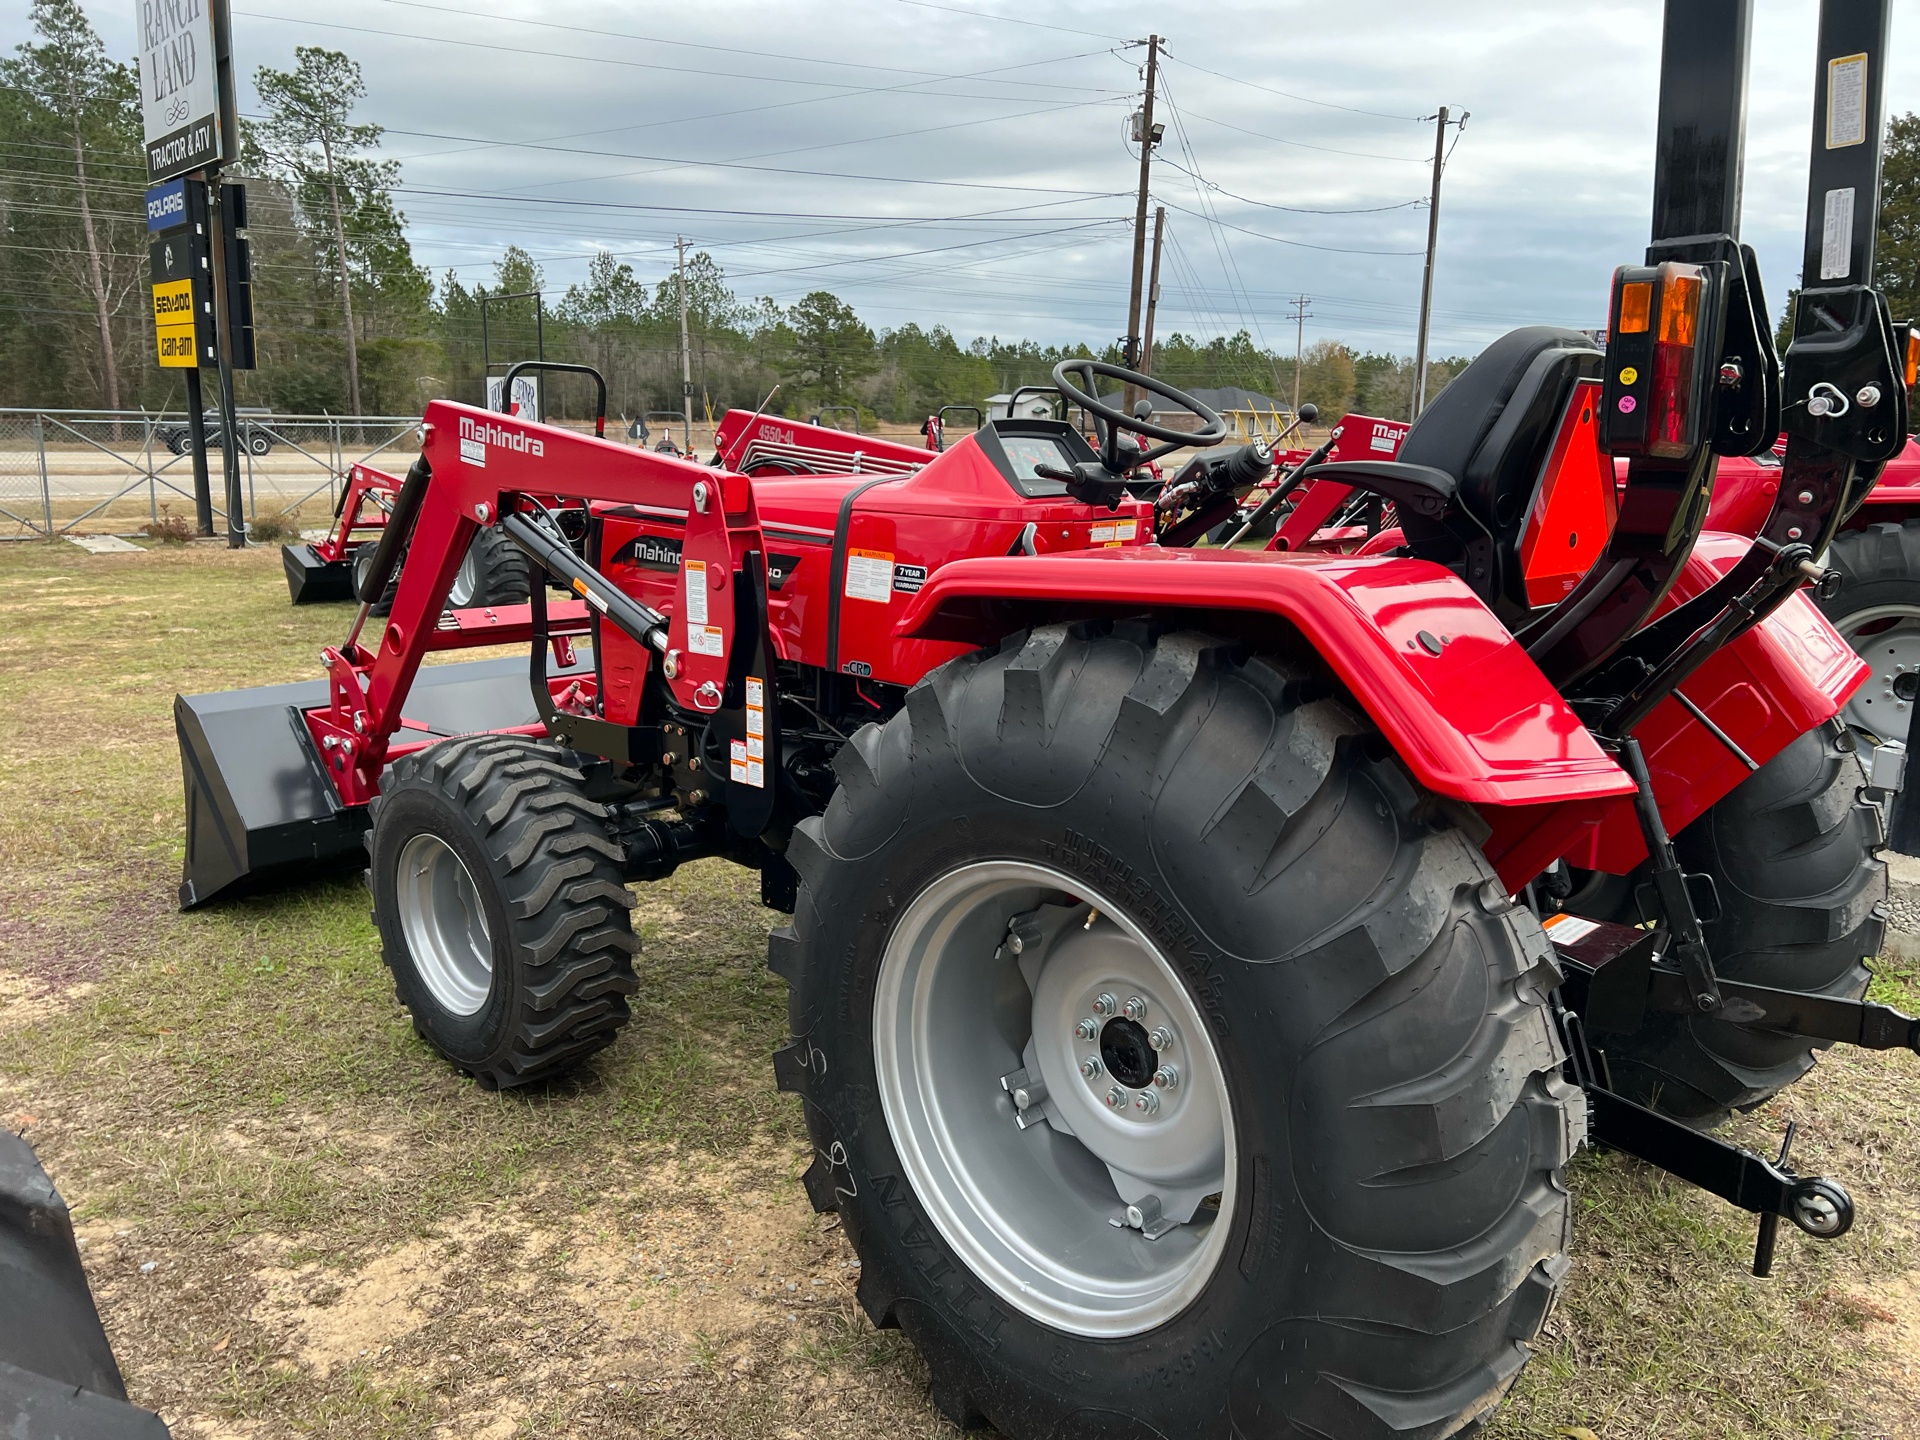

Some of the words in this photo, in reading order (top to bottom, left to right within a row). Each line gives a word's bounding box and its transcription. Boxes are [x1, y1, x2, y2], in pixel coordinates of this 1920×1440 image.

[151, 30, 196, 103] LAND
[151, 137, 187, 171] TRACTOR
[187, 133, 194, 156] &
[195, 125, 210, 153] ATV
[148, 192, 184, 220] POLARIS
[459, 416, 544, 457] Mahindra
[899, 567, 905, 576] 7
[905, 569, 921, 578] YEAR
[1040, 838, 1177, 951] TRACTOR
[1063, 827, 1226, 999] INDUSTRIAL
[863, 1168, 1010, 1352] TITAN
